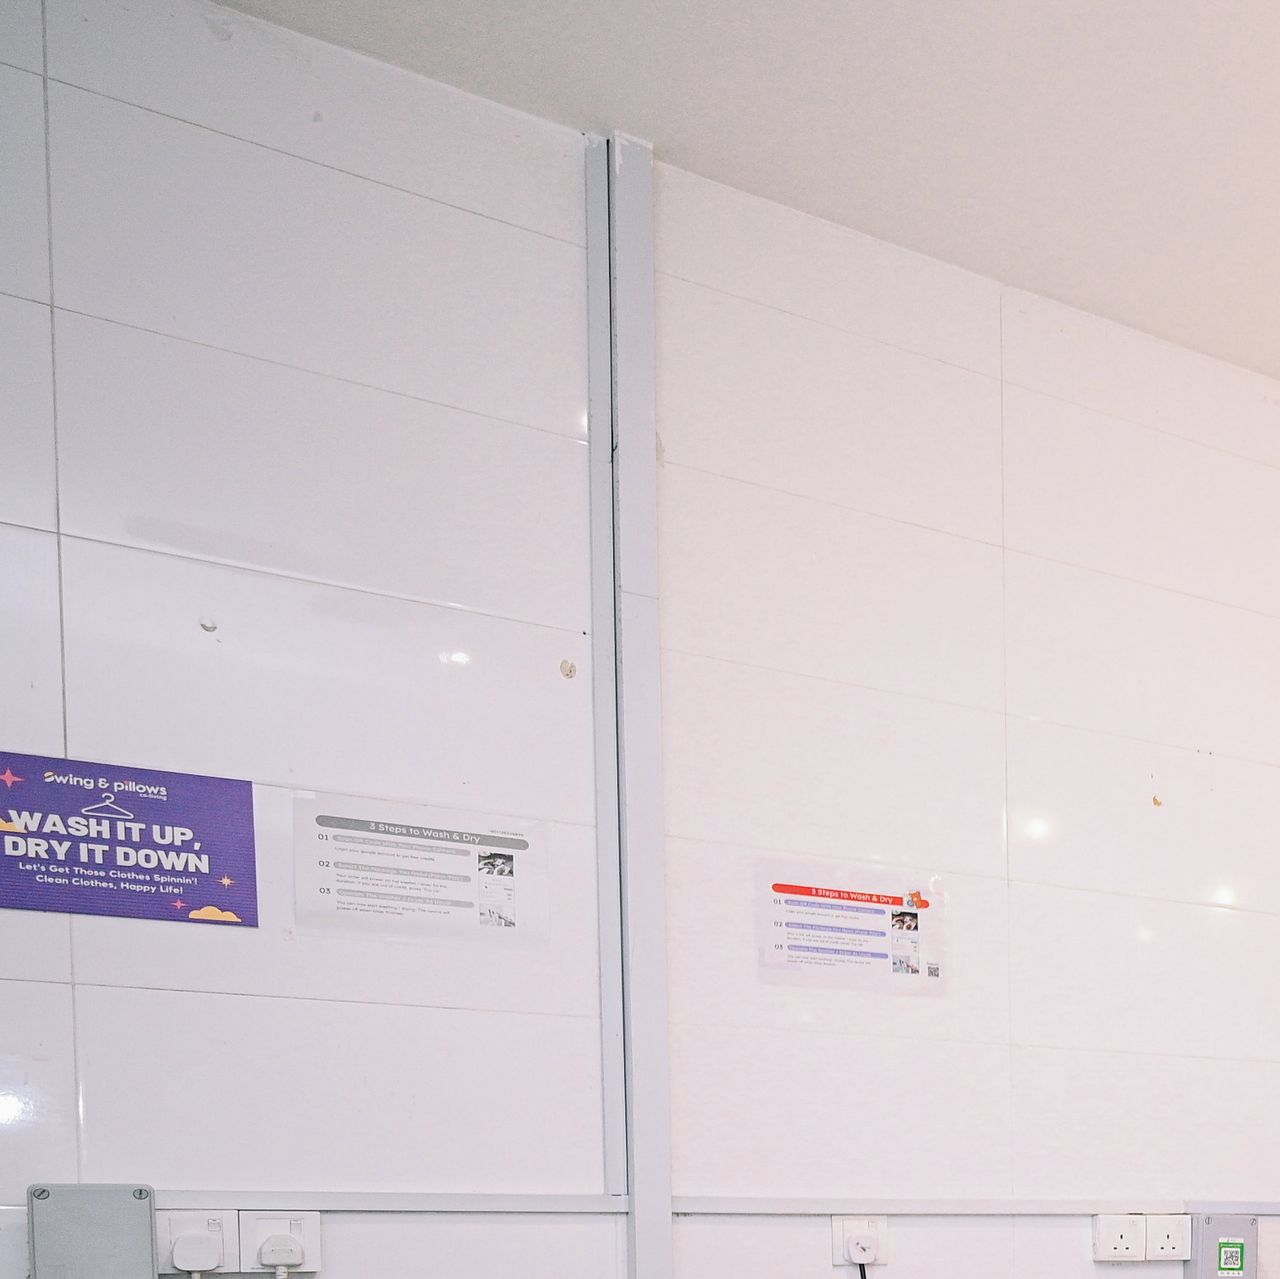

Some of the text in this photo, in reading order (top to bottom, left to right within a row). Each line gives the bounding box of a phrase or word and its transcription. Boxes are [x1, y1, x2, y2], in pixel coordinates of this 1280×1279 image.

[98, 777, 109, 788] &
[113, 778, 168, 796] pillows
[8, 809, 201, 850] WASH IT UP,
[317, 833, 329, 841] 01
[369, 822, 376, 830] 3
[378, 823, 407, 834] Steps
[409, 828, 420, 836] to
[422, 828, 450, 839] Wash
[463, 834, 480, 844] Dry
[4, 835, 210, 874] DRY IT DOWN
[318, 860, 330, 868] 02
[19, 862, 46, 872] Let's
[49, 864, 70, 875] Get
[73, 867, 106, 878] Those
[109, 869, 151, 881] Clothes
[36, 875, 184, 895] Clean Clothes, Happy Life!
[319, 887, 331, 895] 03
[818, 889, 839, 899] Steps
[850, 892, 871, 901] Wash
[879, 896, 893, 904] Dry
